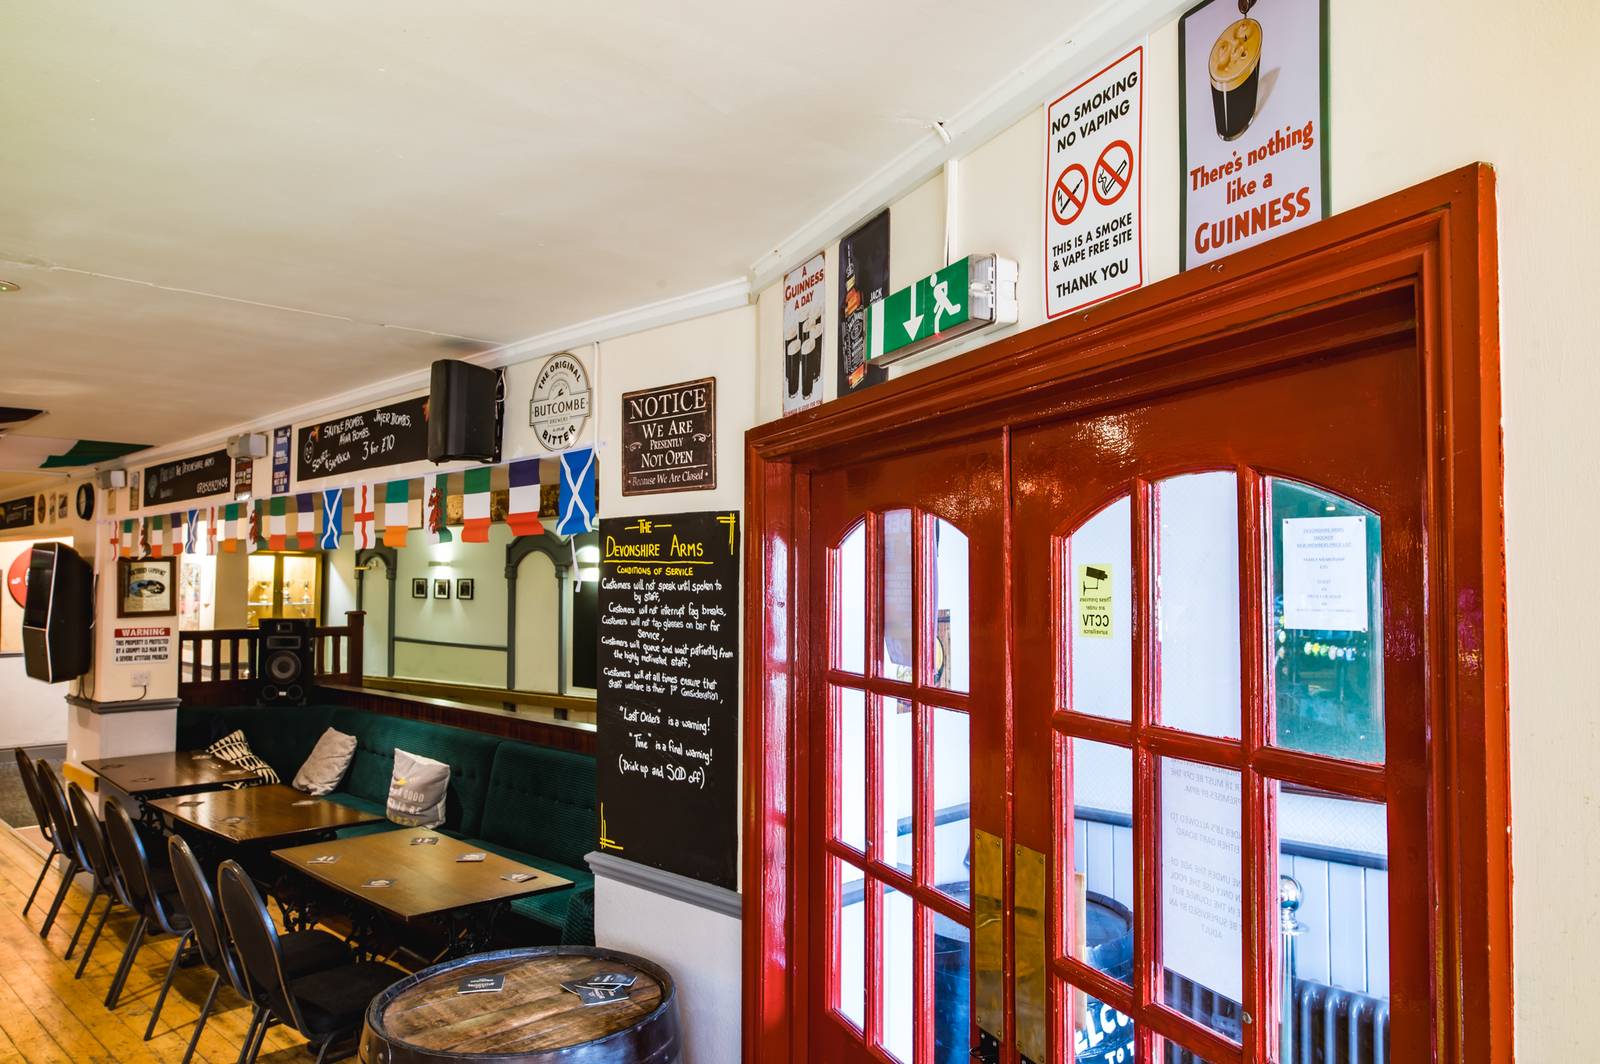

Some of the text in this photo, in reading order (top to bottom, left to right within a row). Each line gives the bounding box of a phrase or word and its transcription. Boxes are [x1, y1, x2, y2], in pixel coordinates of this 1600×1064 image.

[1052, 72, 1138, 134] NO SMOKING
[1057, 100, 1130, 153] NO VAPING
[1190, 120, 1314, 191] There's nothing
[1226, 172, 1272, 205] like a
[1194, 186, 1311, 254] GUINNESS
[1052, 212, 1132, 257] THIS IS A SMOKE
[1052, 229, 1132, 272] & VAPE FREE SITE
[802, 266, 807, 276] A
[1056, 258, 1128, 298] THANK YOU
[784, 268, 824, 302] GUINNESS
[870, 288, 883, 302] JACK
[794, 290, 814, 311] A DAY
[538, 360, 582, 390] THE ORIGINAL
[534, 398, 586, 418] BUTCOMBE
[630, 388, 706, 420] NOTICE
[542, 424, 576, 445] BITTER
[362, 441, 370, 460] 3
[632, 469, 704, 486] Because We Are Closed
[638, 519, 652, 534] THE
[606, 534, 704, 558] DEVONSHIRE ARMS
[602, 578, 722, 594] Customers will not speak until spoken to
[634, 591, 642, 604] by
[608, 602, 636, 614] Customers
[638, 604, 648, 614] will
[648, 605, 658, 614] not
[660, 604, 686, 618] interrupt
[688, 602, 699, 620] fag
[122, 628, 166, 636] WARNING
[602, 614, 628, 626] Customers
[630, 616, 640, 626] will
[642, 618, 650, 626] not
[652, 618, 662, 630] tap
[662, 618, 684, 631] glasses
[696, 620, 708, 630] bar
[710, 620, 720, 632] for
[601, 636, 734, 660] Customers will queue and wait patiently from
[613, 650, 624, 660] the
[624, 650, 640, 666] highly
[641, 654, 668, 666] motivated
[603, 666, 718, 690] Customers will at all times ensure that
[624, 680, 644, 692] welfare
[646, 684, 652, 692] is
[652, 682, 666, 694] their
[668, 716, 674, 726] is
[674, 718, 680, 727] a
[682, 716, 710, 736] warning!
[656, 741, 662, 750] is
[662, 744, 666, 752] a
[668, 740, 683, 756] final
[686, 748, 712, 766] warning!
[640, 765, 649, 778] up
[652, 766, 664, 778] and
[666, 764, 686, 780] SOD
